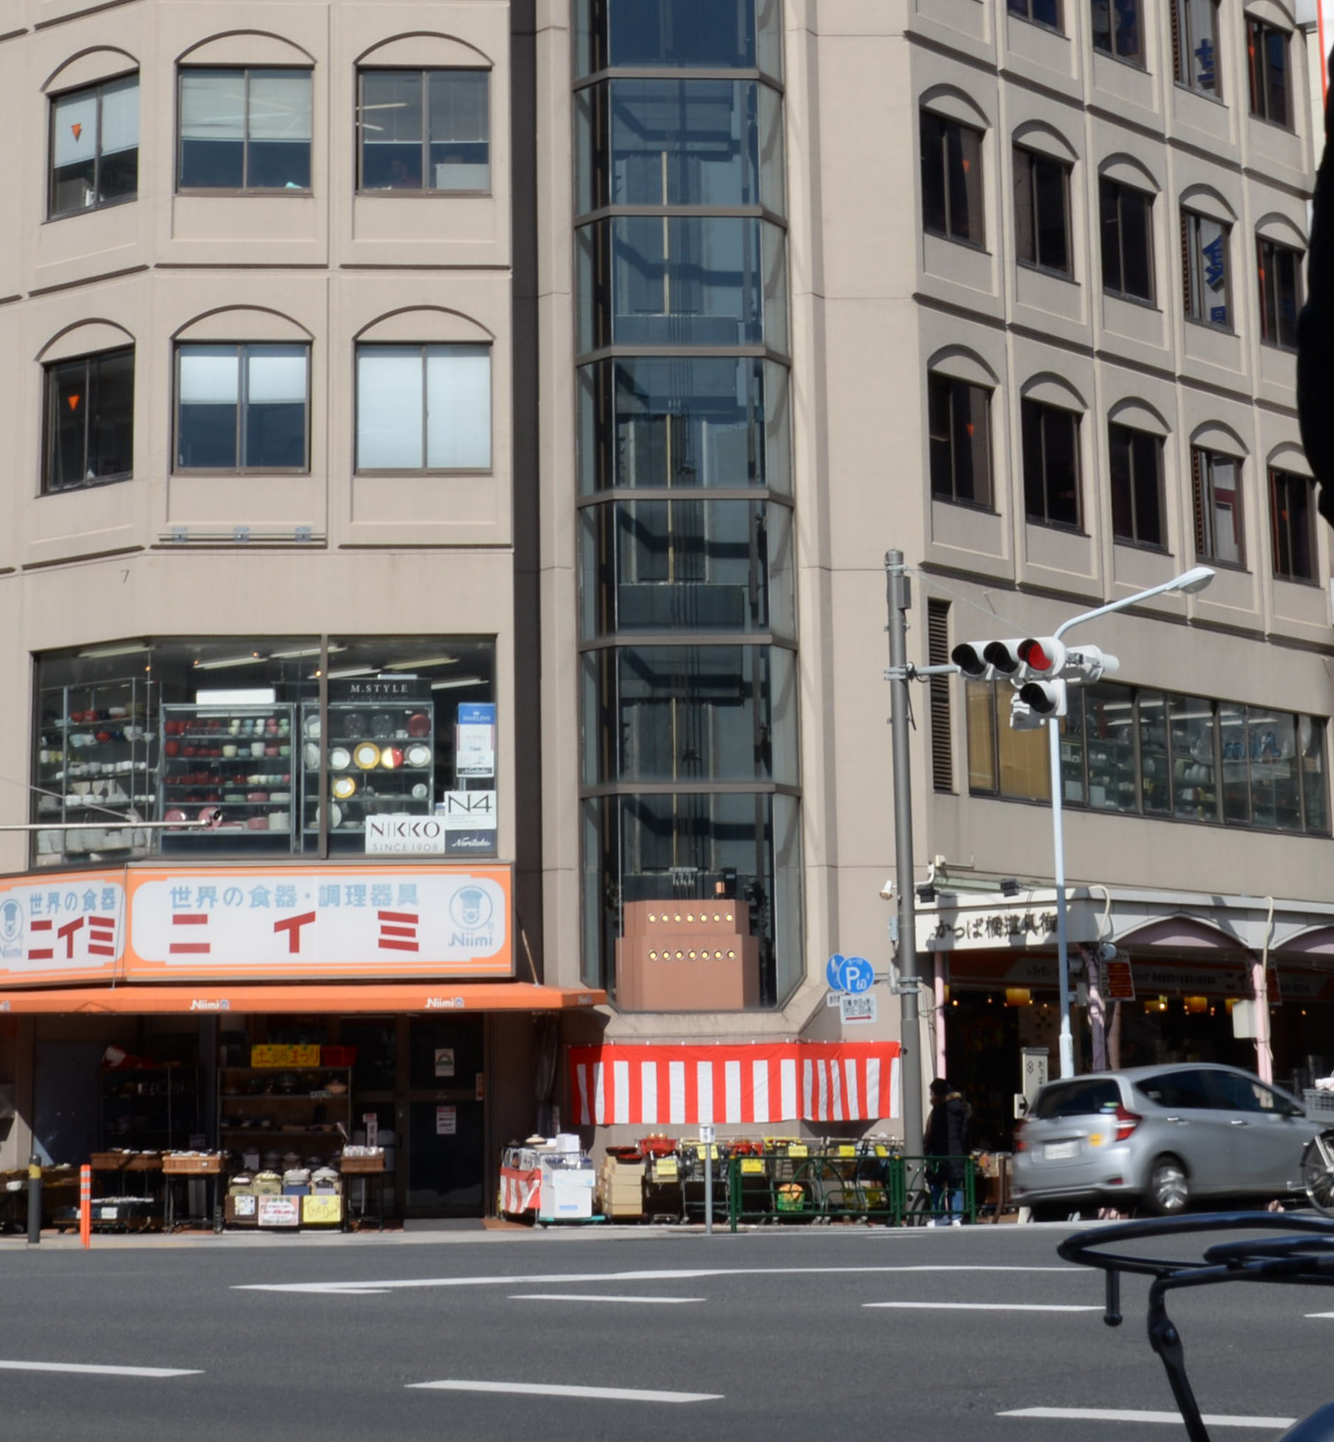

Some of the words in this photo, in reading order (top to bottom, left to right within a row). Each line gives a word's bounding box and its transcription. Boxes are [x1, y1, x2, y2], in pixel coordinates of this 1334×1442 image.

[350, 684, 408, 693] M.STYLE
[448, 794, 492, 813] N4
[371, 821, 440, 838] NIKKO
[373, 843, 407, 852] SINCE
[411, 843, 438, 852] 1908
[28, 885, 117, 915] 世界の食器
[169, 883, 419, 909] 世界の食器・調理器具
[28, 915, 115, 960] ニイミ
[169, 911, 419, 953] ニイミ
[448, 932, 493, 949] Niimi
[190, 999, 220, 1011] Niimi
[424, 997, 454, 1009] Niimi
